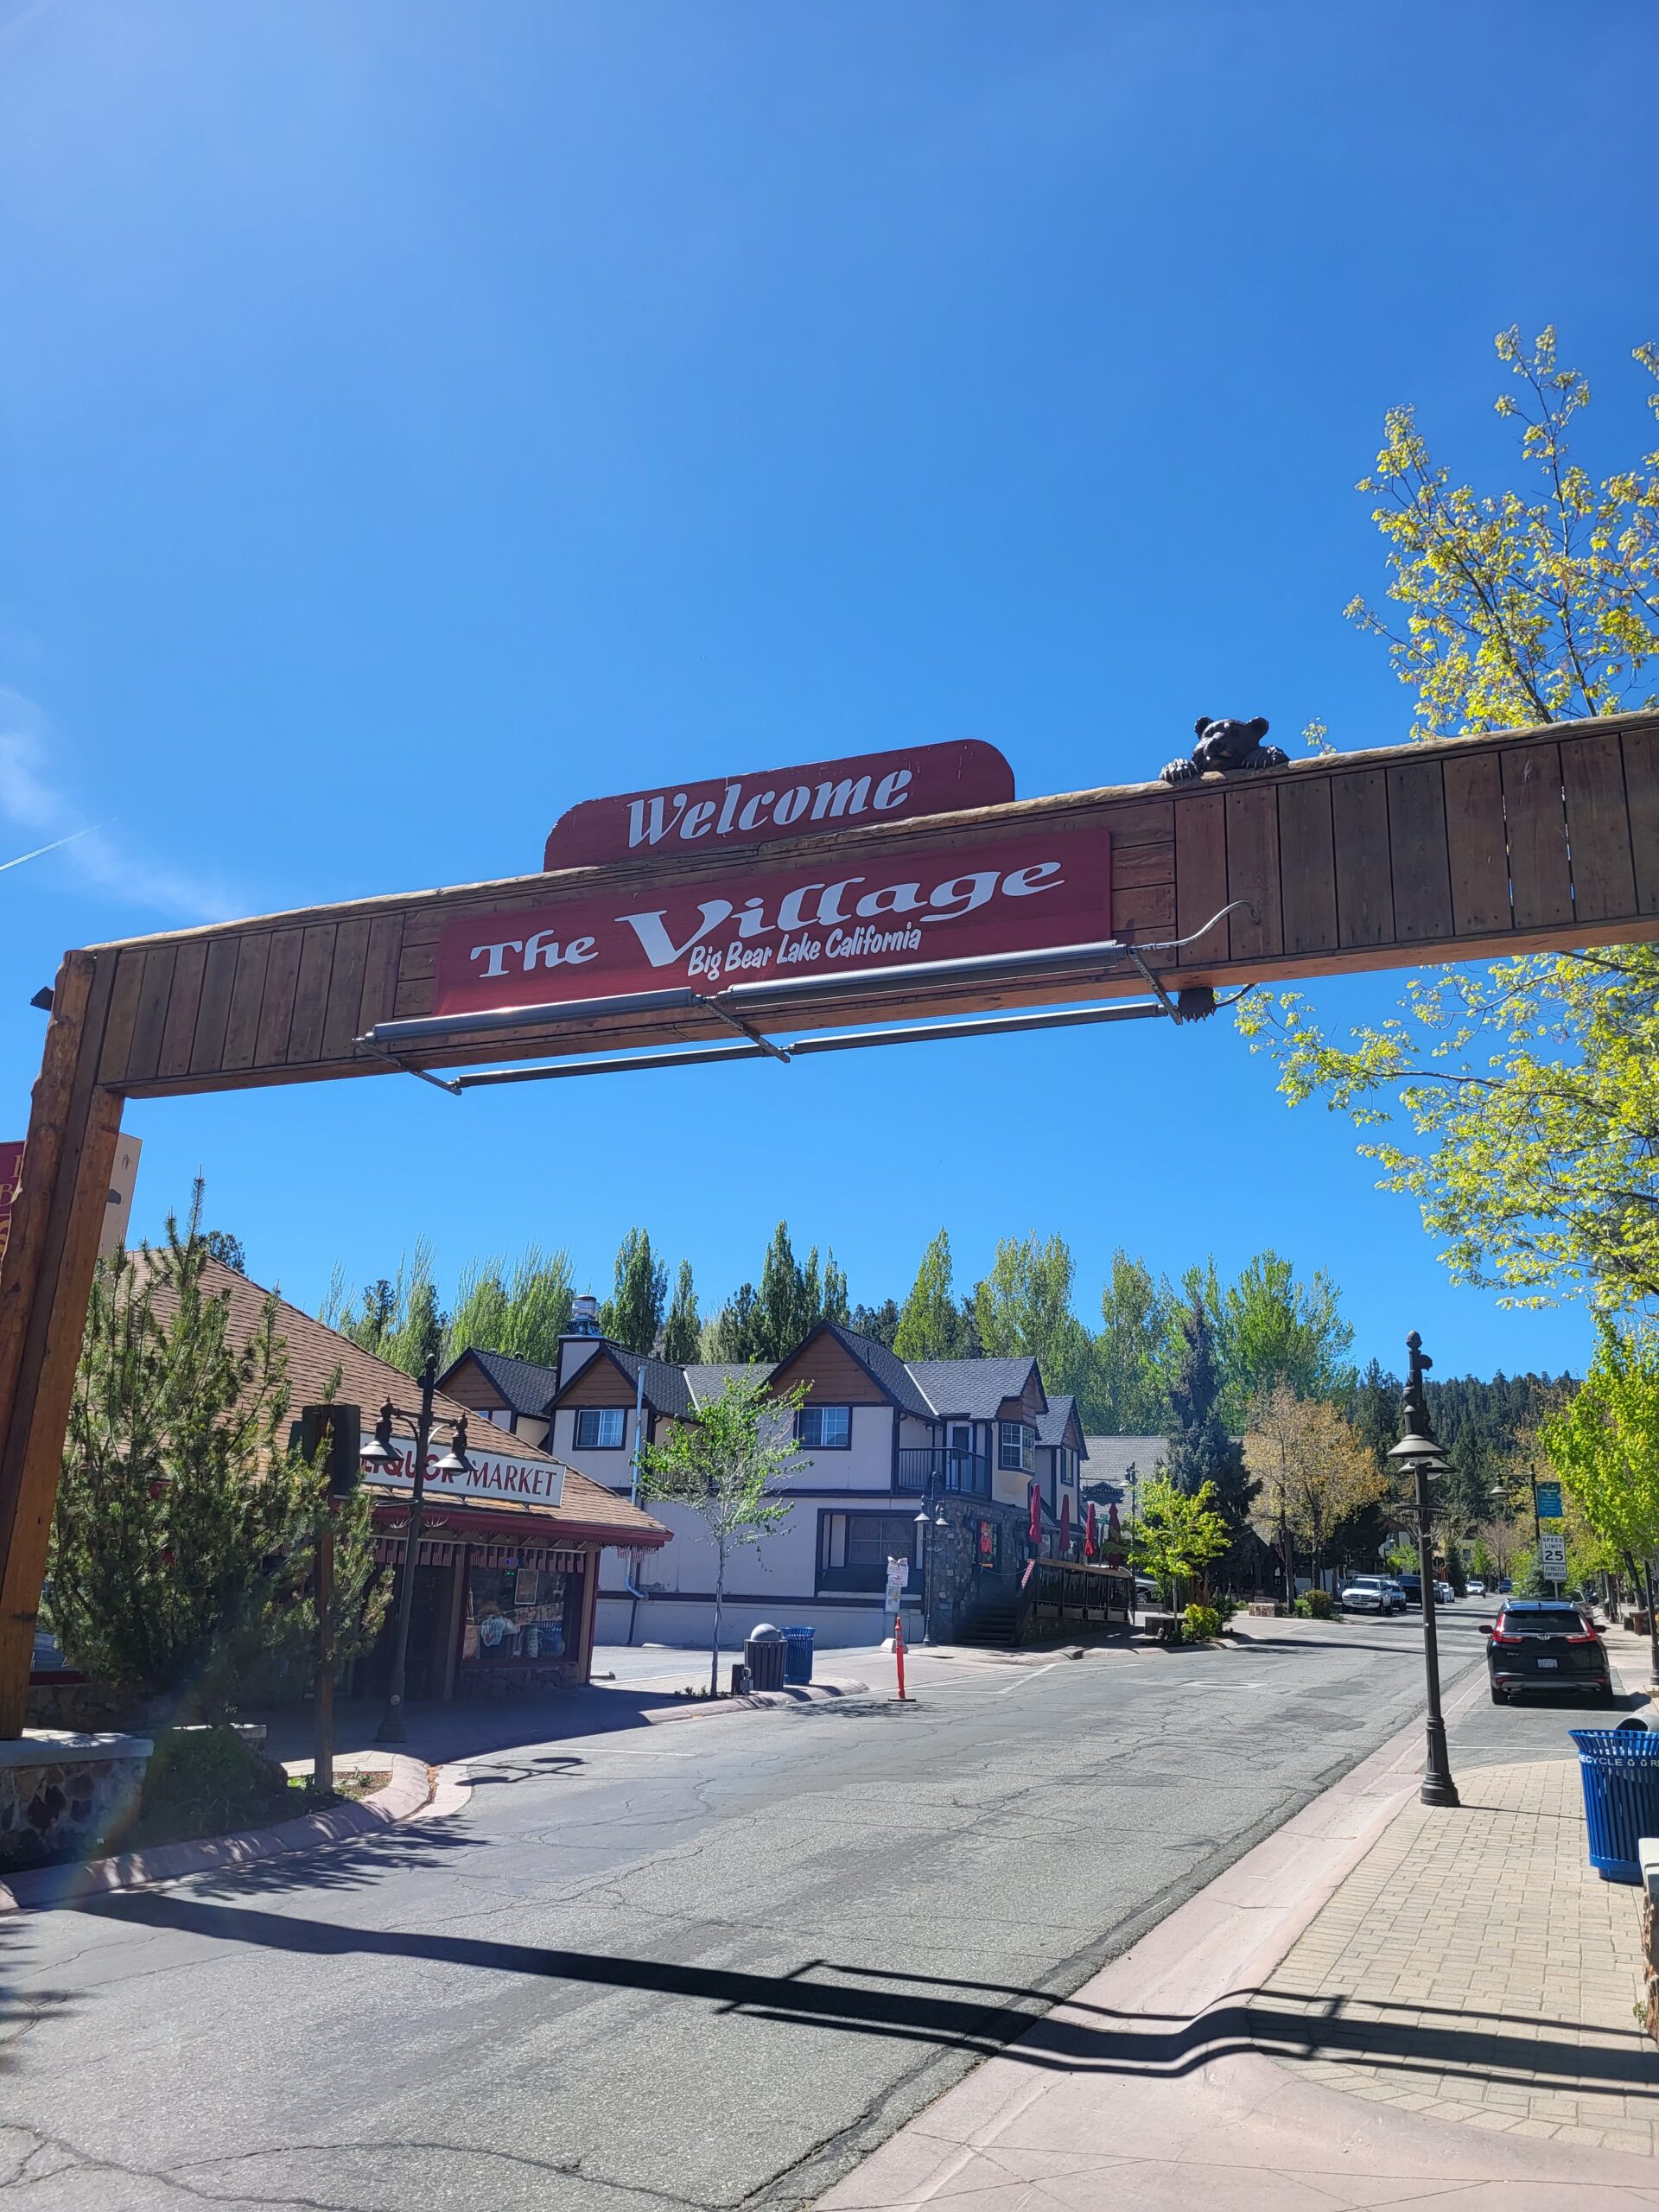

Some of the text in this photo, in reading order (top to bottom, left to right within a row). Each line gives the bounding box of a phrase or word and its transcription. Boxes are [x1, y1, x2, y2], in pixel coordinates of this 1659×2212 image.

[626, 769, 912, 849] Welcome
[470, 861, 1065, 978] The Village
[687, 921, 923, 981] Big Bear Lake California
[466, 1460, 558, 1497] MARKET
[1545, 1550, 1563, 1560] 25
